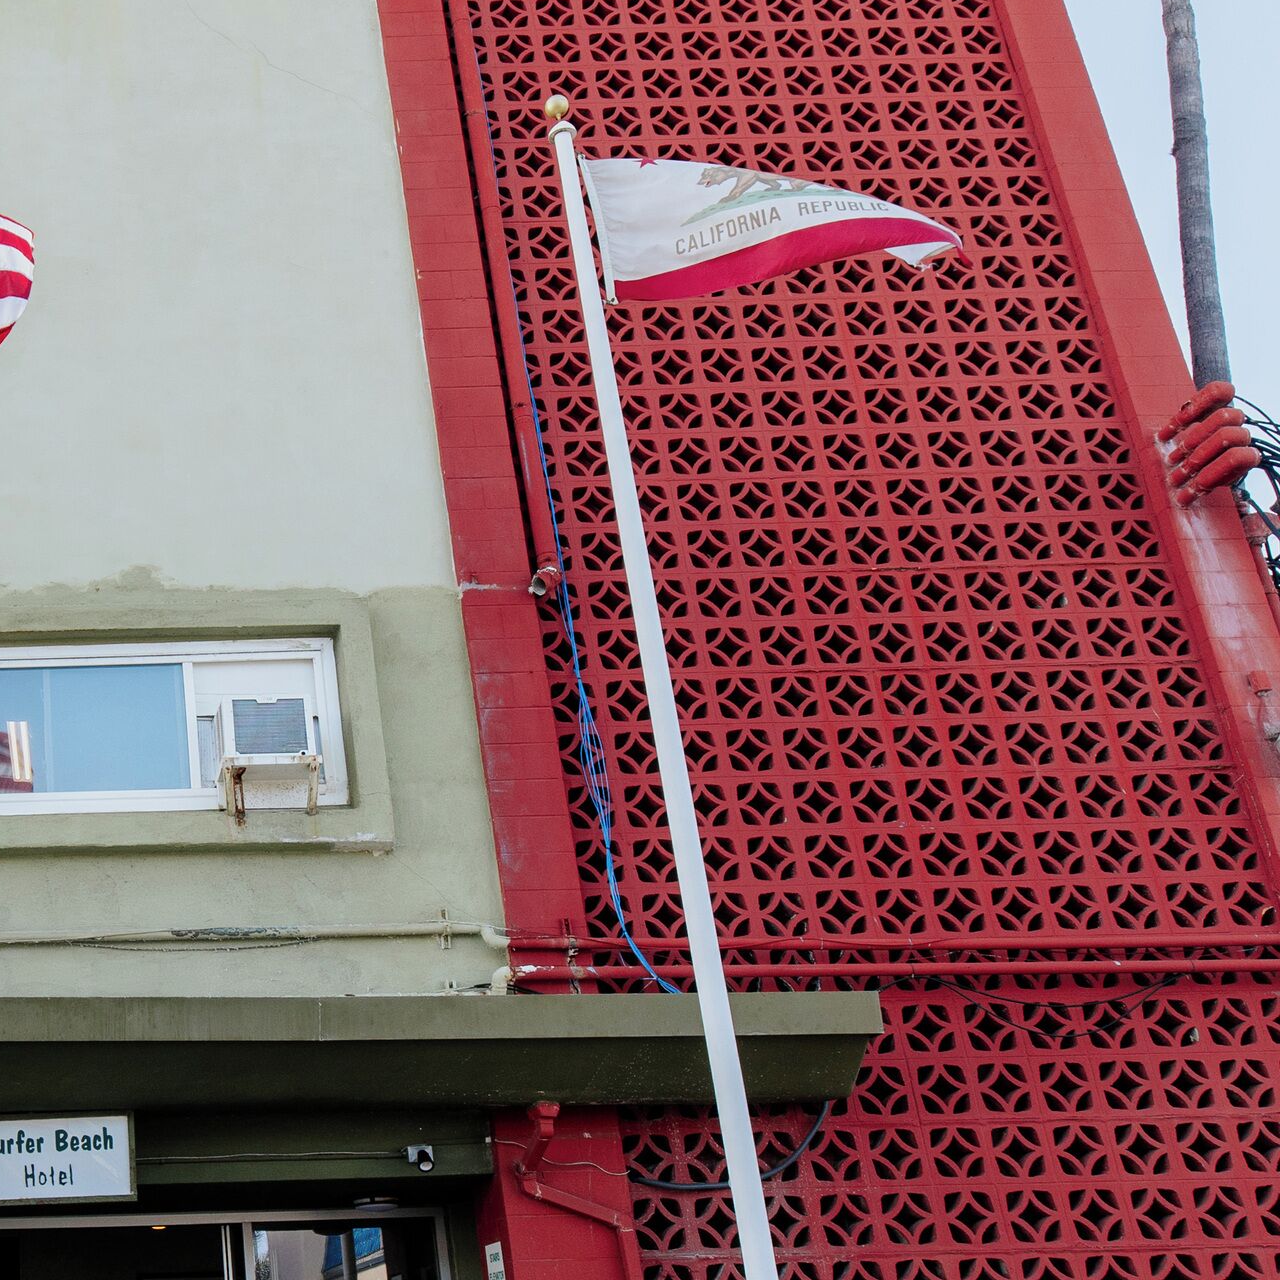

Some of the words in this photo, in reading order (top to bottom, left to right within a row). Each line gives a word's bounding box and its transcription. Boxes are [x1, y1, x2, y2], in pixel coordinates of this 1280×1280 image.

[675, 206, 782, 255] CALIFORNIA
[798, 200, 889, 216] REPUBLIC
[55, 1126, 113, 1152] Beach
[24, 1163, 74, 1187] Hotel
